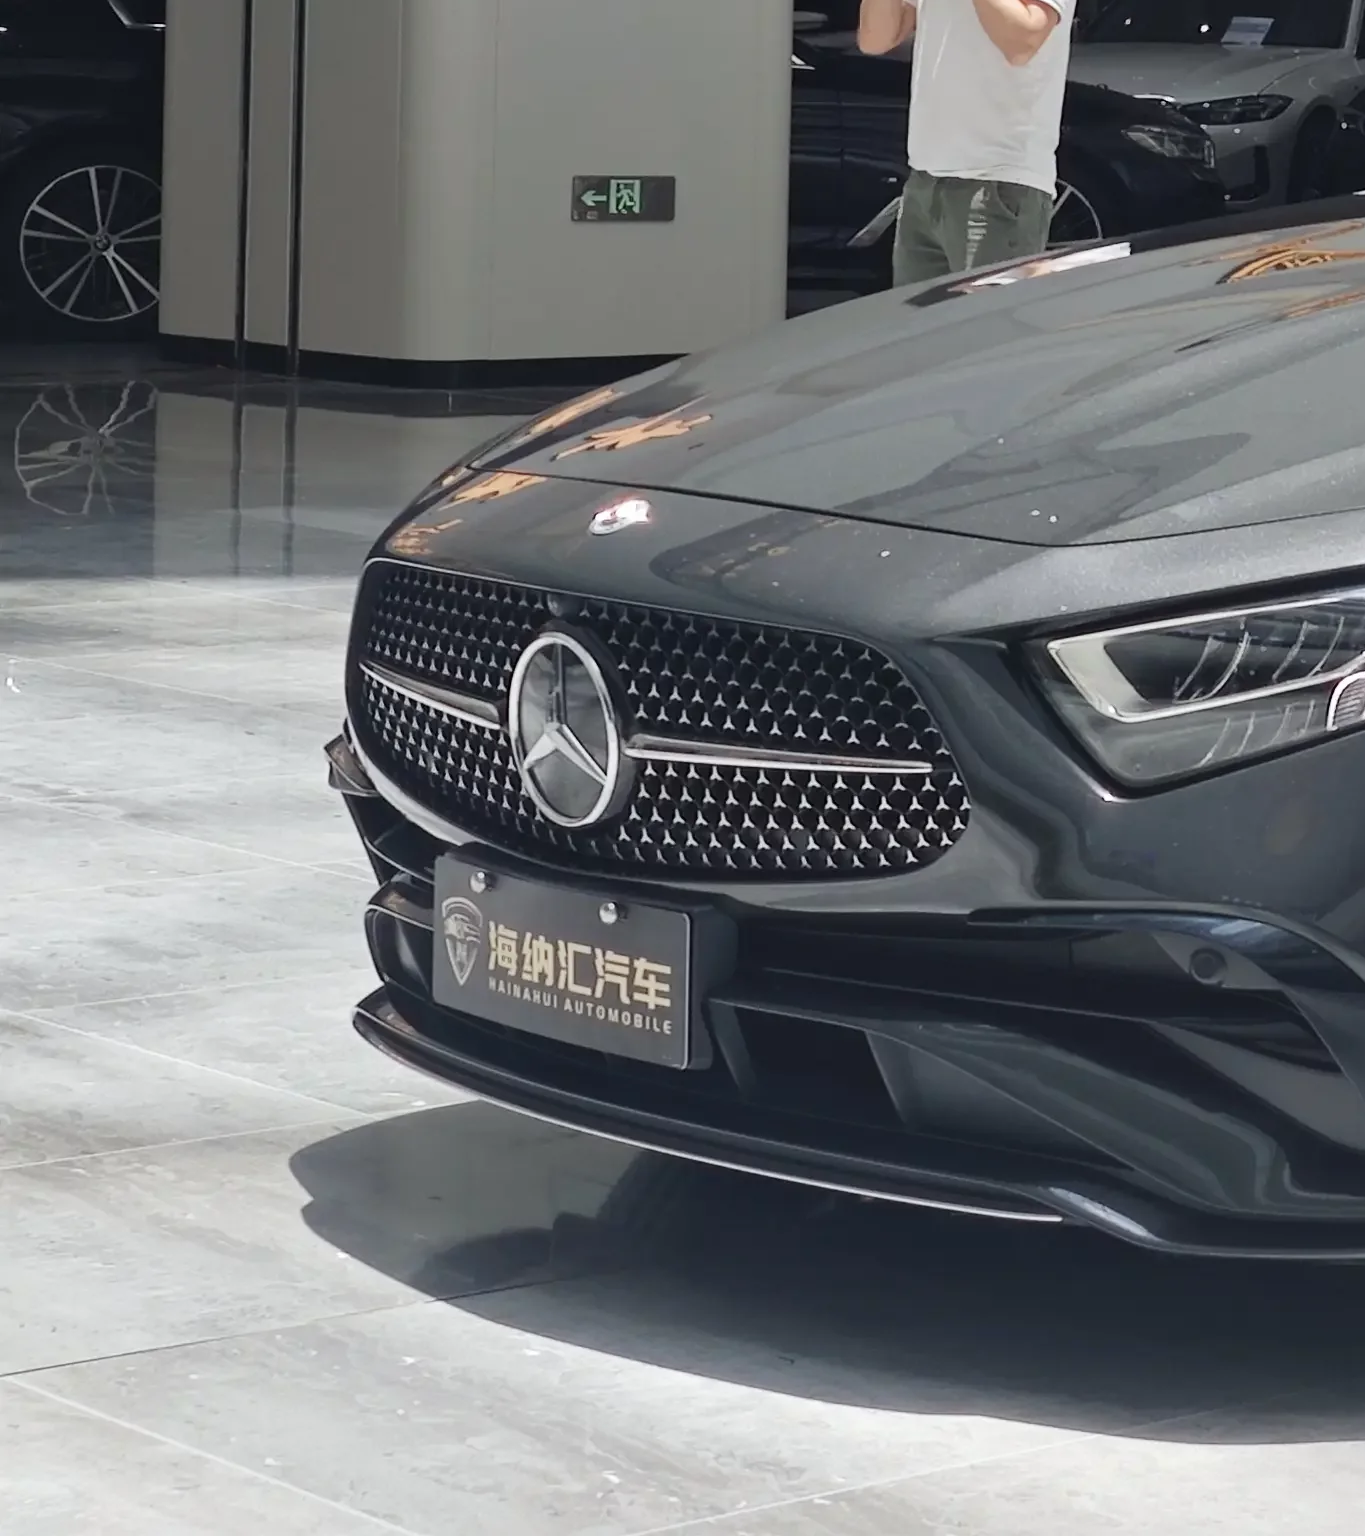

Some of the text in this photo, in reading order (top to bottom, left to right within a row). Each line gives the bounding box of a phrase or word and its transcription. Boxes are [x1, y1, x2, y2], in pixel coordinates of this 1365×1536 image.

[488, 920, 672, 1011] 海纳汇汽车
[488, 975, 673, 1036] HAINAHUI AUTOMOBILE
